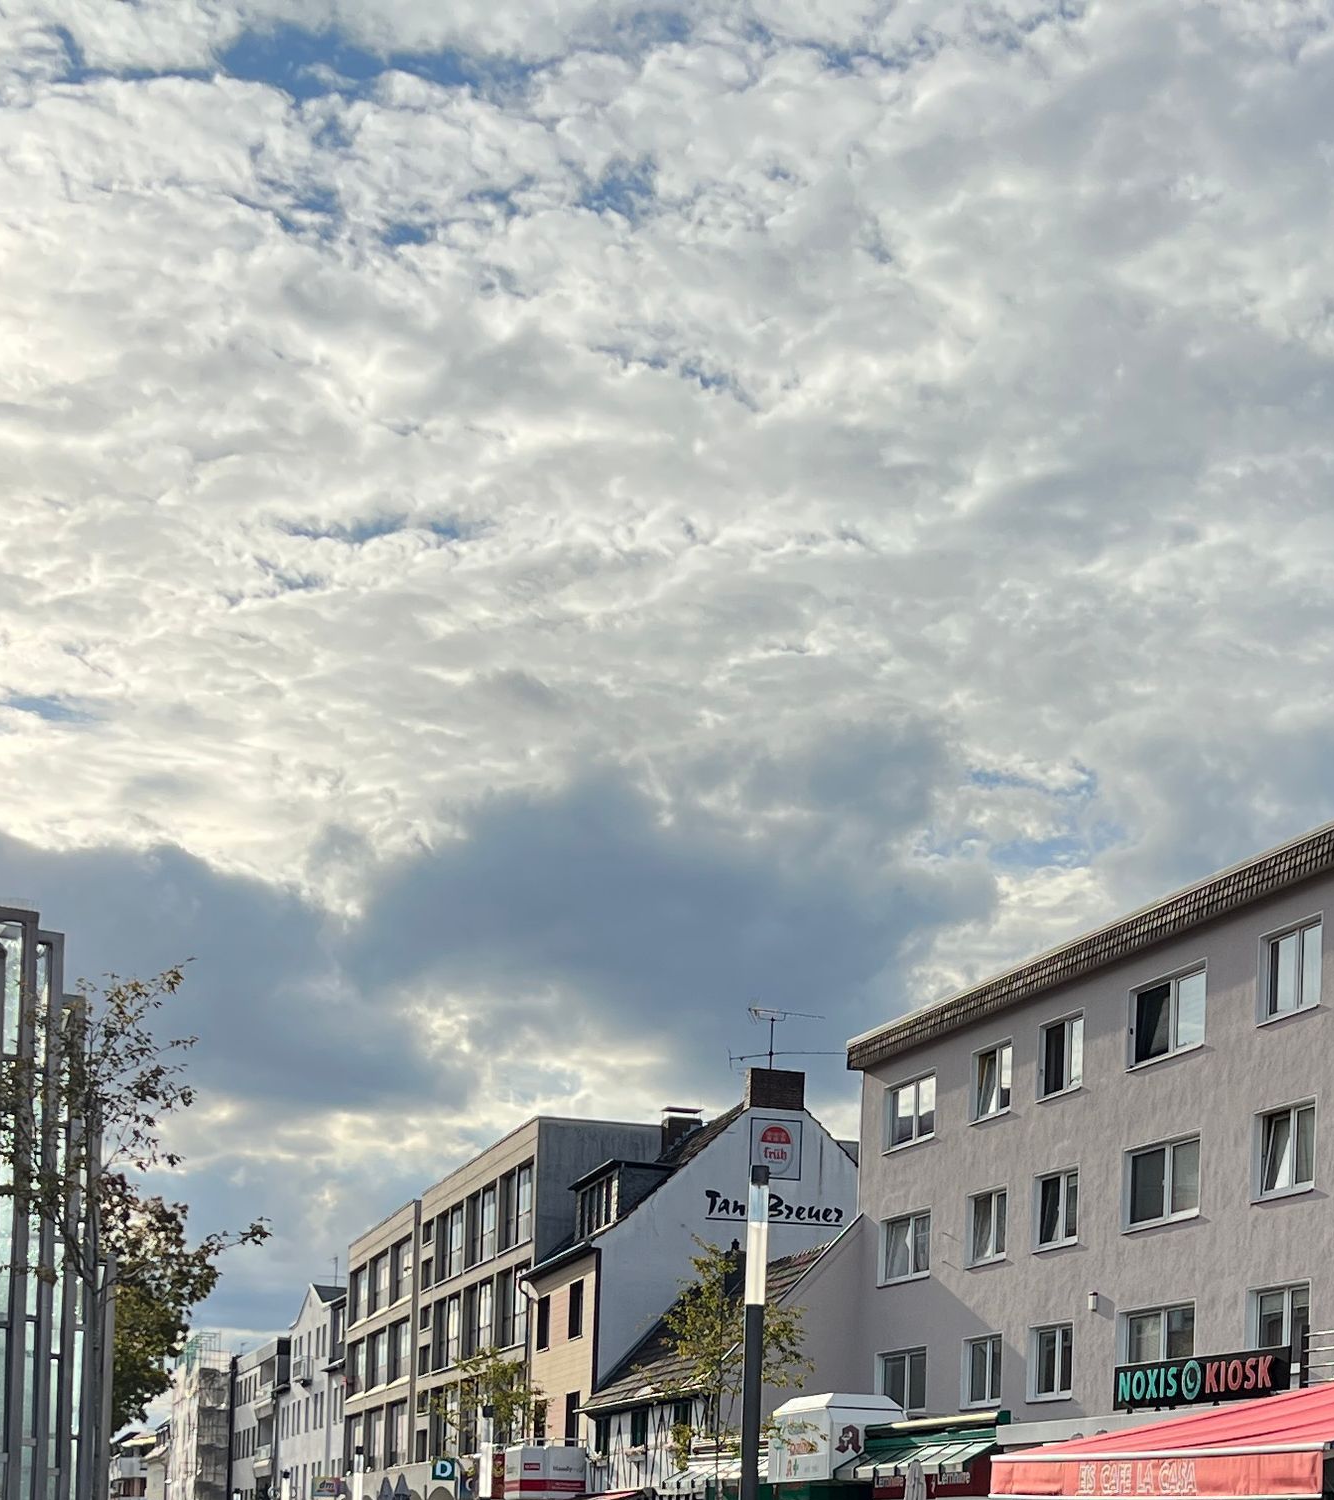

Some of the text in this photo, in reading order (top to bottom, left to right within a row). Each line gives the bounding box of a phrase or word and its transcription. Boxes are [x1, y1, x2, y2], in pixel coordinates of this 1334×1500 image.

[768, 1192, 844, 1223] Breuer
[1117, 1354, 1275, 1402] NOXIS KIOSK
[435, 1460, 454, 1478] D
[1136, 1461, 1155, 1493] LA
[1158, 1460, 1197, 1493] CASA
